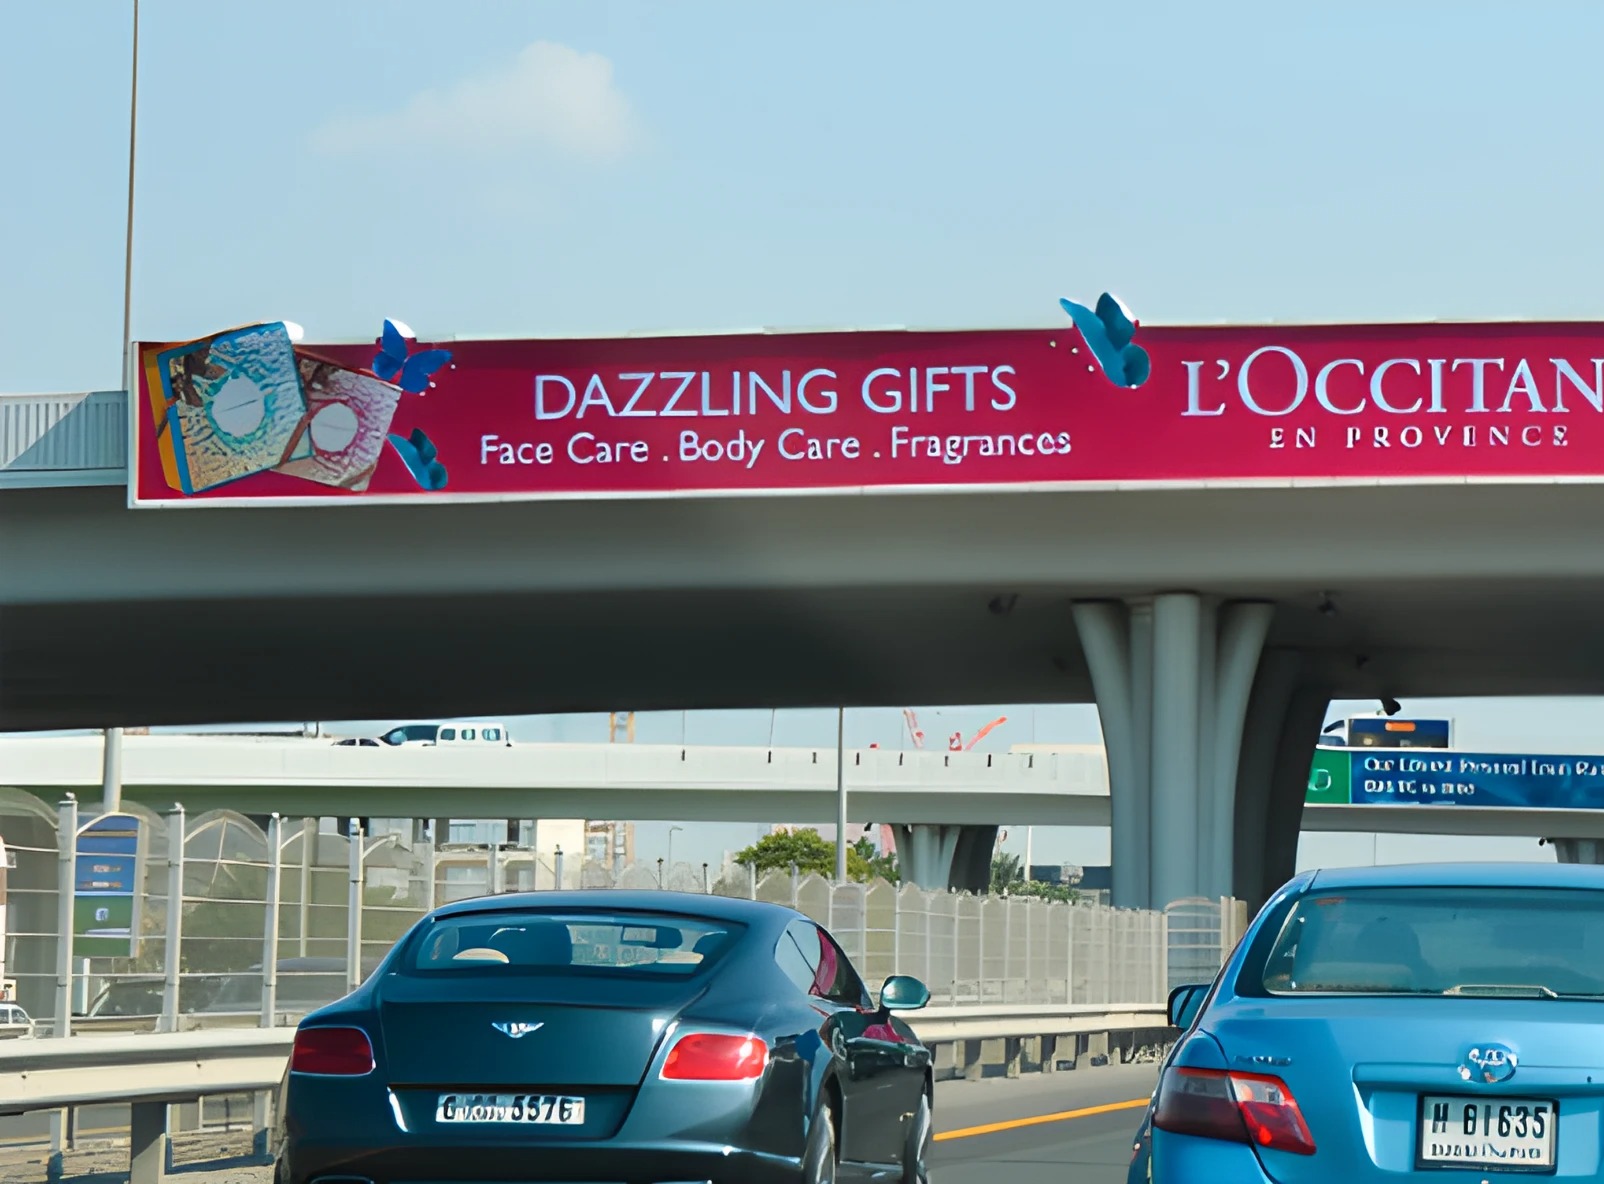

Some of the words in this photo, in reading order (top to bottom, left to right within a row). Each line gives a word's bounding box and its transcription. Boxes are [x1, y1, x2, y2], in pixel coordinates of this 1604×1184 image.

[533, 368, 839, 421] DAZZLING
[861, 365, 1017, 413] GIFTS
[480, 434, 553, 465] Face
[567, 431, 649, 464] Care
[678, 429, 765, 469] Body
[777, 427, 860, 460] Care
[1269, 427, 1316, 449] EN
[1346, 425, 1569, 449] PROVINCE
